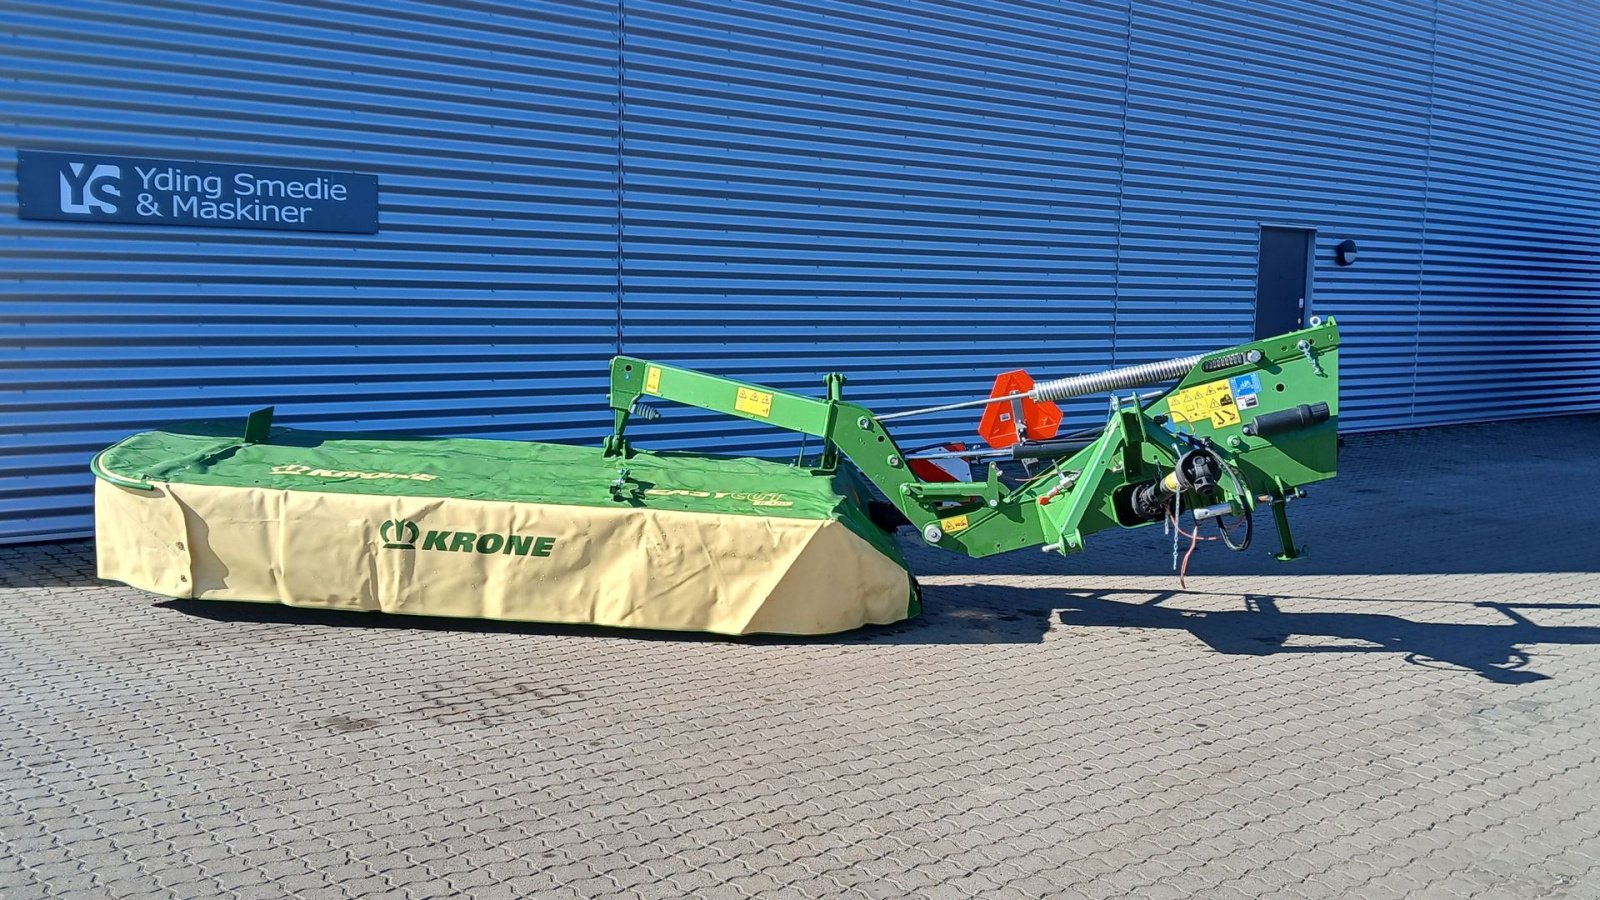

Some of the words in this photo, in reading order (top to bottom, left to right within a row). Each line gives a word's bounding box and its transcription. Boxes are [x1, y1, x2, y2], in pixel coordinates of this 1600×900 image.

[134, 166, 223, 199] Yding
[234, 173, 348, 201] Smedie
[136, 194, 163, 217] &
[172, 196, 312, 223] Maskiner
[423, 530, 556, 557] KRONE
